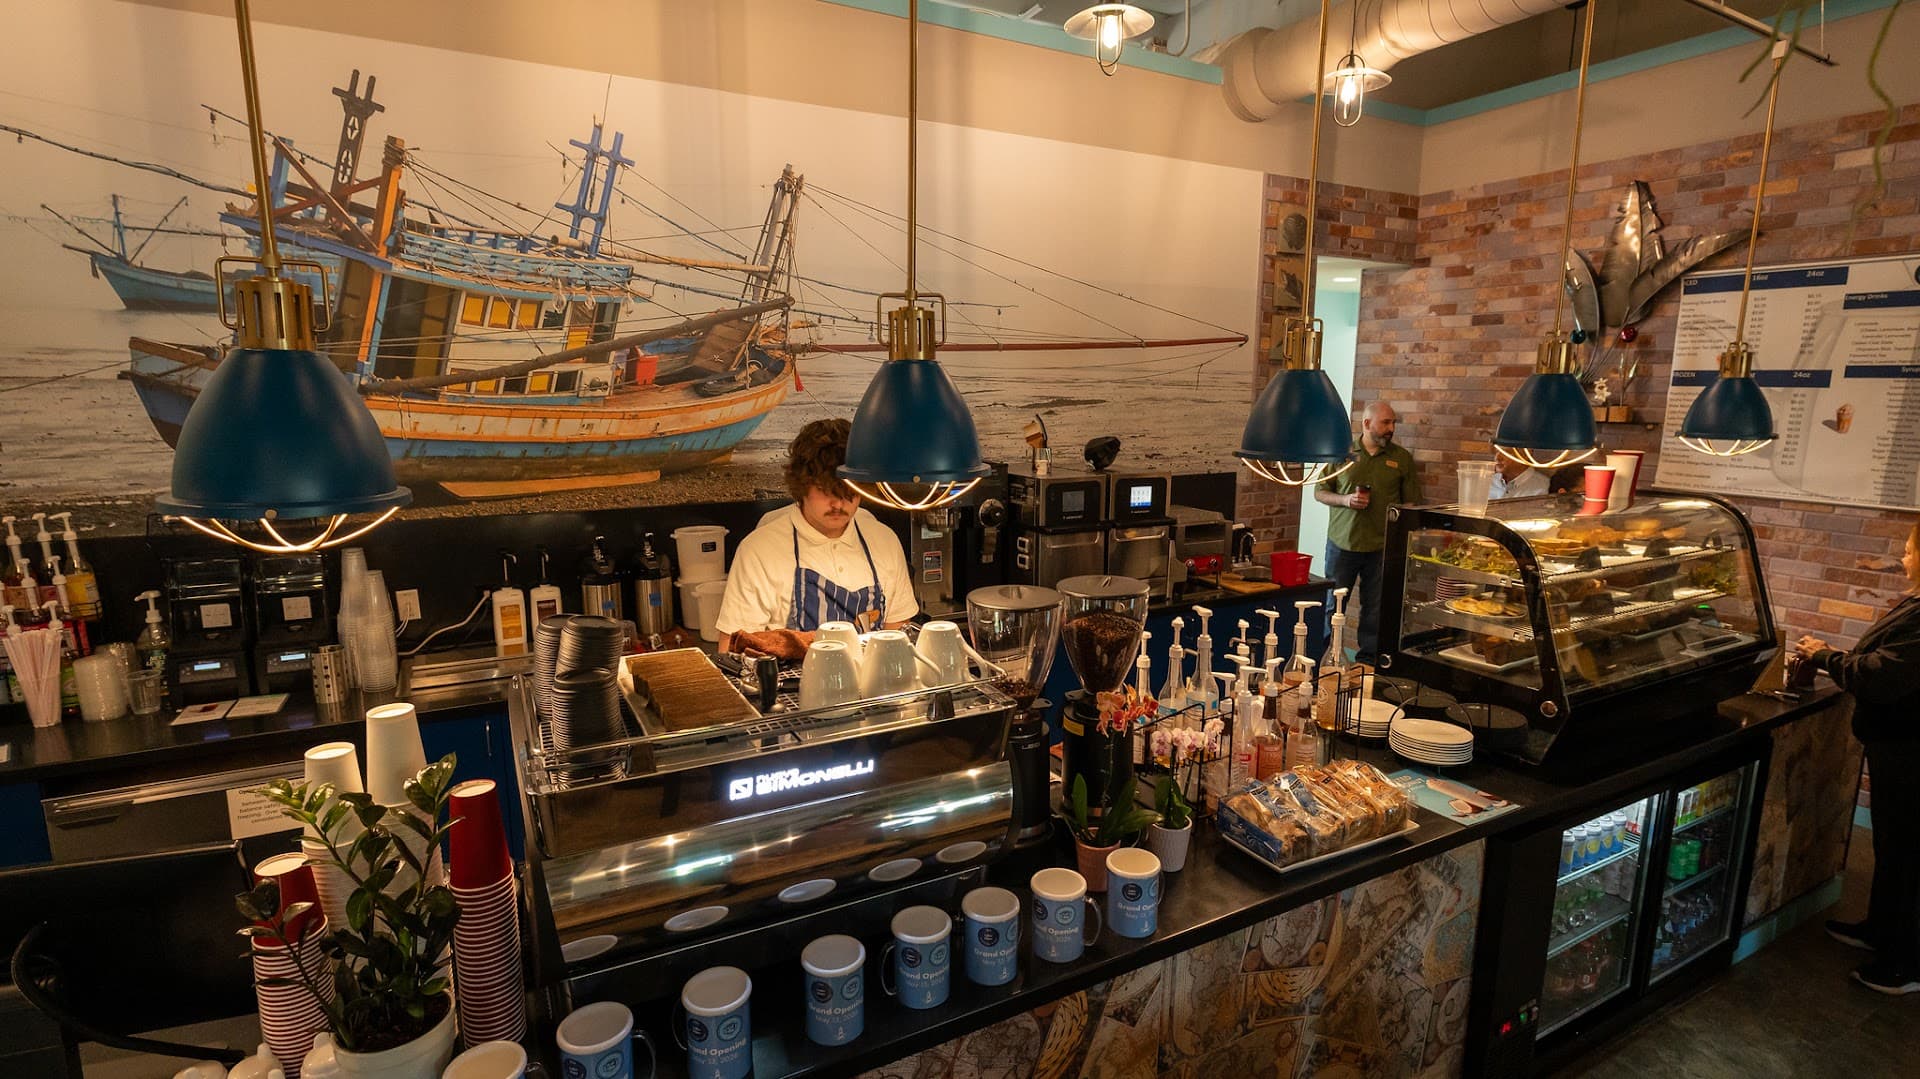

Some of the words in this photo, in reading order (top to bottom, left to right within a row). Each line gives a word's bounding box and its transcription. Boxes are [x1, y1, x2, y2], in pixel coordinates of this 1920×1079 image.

[1806, 270, 1824, 278] 24oz
[755, 759, 875, 795] SIMONELLI
[709, 1037, 747, 1056] Opening
